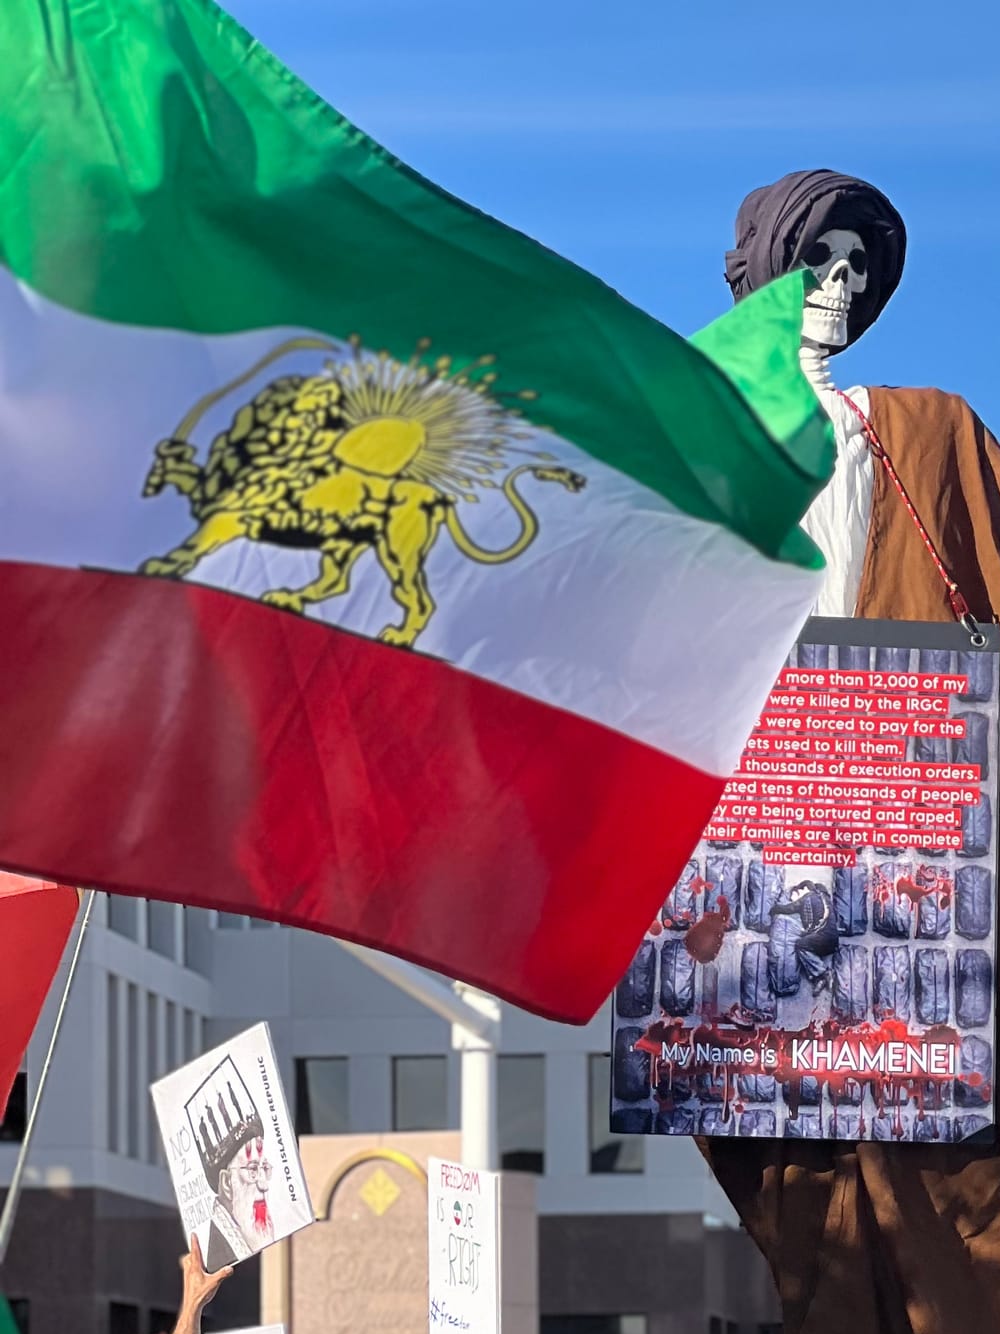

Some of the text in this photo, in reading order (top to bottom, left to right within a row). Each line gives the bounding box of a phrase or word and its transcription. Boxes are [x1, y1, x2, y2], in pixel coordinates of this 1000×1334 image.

[786, 673, 825, 684] more
[829, 672, 864, 686] than
[868, 674, 919, 689] 12,000
[923, 676, 939, 688] of
[943, 680, 966, 693] my
[770, 694, 947, 712] were killed by the IRGC.
[766, 717, 801, 728] were
[806, 716, 854, 730] forced
[859, 719, 875, 731] to
[879, 722, 909, 735] pay
[913, 720, 935, 733] for
[940, 722, 964, 735] the
[774, 738, 810, 751] used
[814, 740, 830, 751] to
[835, 740, 856, 752] kill
[860, 741, 902, 754] them.
[745, 759, 824, 774] thousands
[828, 761, 845, 774] of
[849, 764, 921, 777] execution
[925, 766, 978, 780] orders.
[724, 781, 978, 804] sted tens of thousands of people,
[732, 805, 757, 816] are
[762, 804, 805, 820] being
[809, 807, 871, 820] tortured
[876, 809, 905, 821] and
[910, 811, 959, 825] raped,
[741, 825, 800, 839] families
[805, 830, 830, 840] are
[835, 829, 868, 844] kept
[872, 831, 886, 843] in
[890, 832, 961, 847] complete
[765, 850, 854, 866] uncertainty.
[660, 1038, 956, 1075] My Name is KHAMENEI
[257, 1056, 297, 1202] NO TO ISLAMIC REPUBLIC
[169, 1125, 191, 1160] NO
[436, 1197, 445, 1222] IS
[448, 1232, 481, 1290] RIGHT
